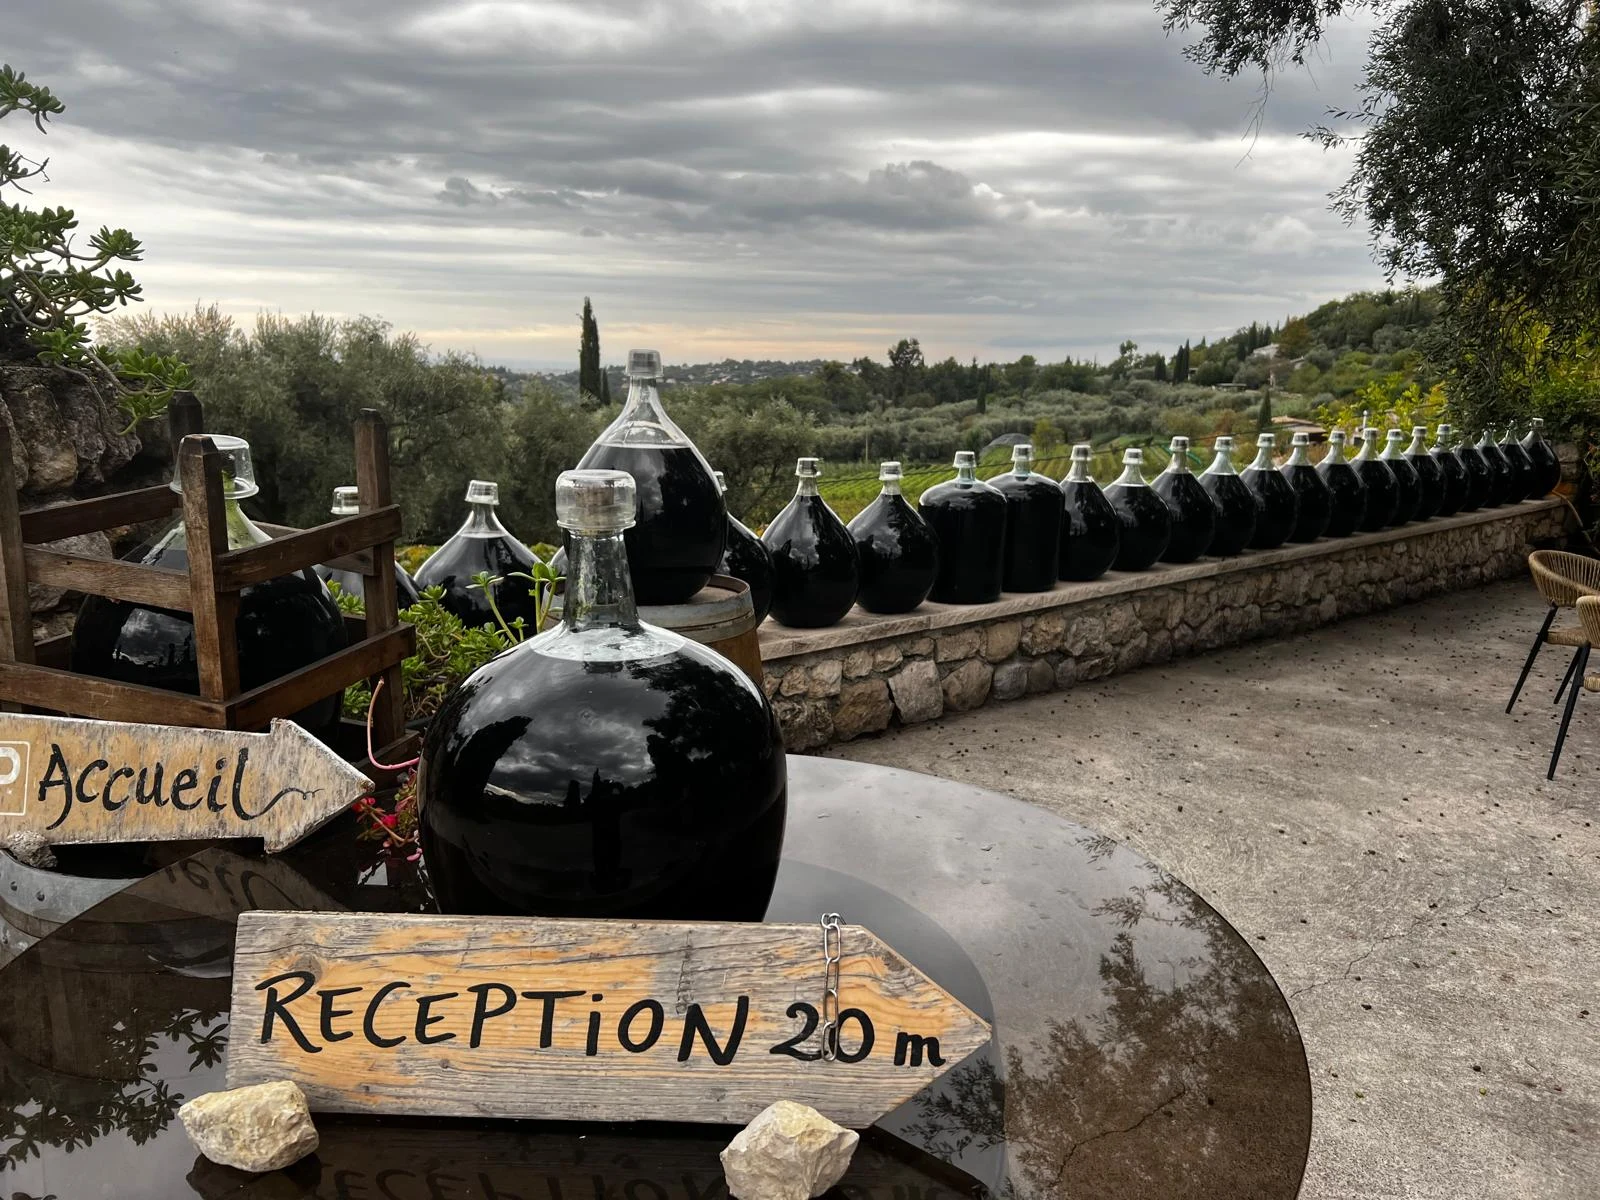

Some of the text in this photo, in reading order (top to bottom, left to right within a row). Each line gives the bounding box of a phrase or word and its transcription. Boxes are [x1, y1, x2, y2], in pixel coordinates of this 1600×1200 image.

[38, 743, 315, 830] Accueil
[769, 1002, 875, 1063] 20
[894, 1032, 946, 1067] m
